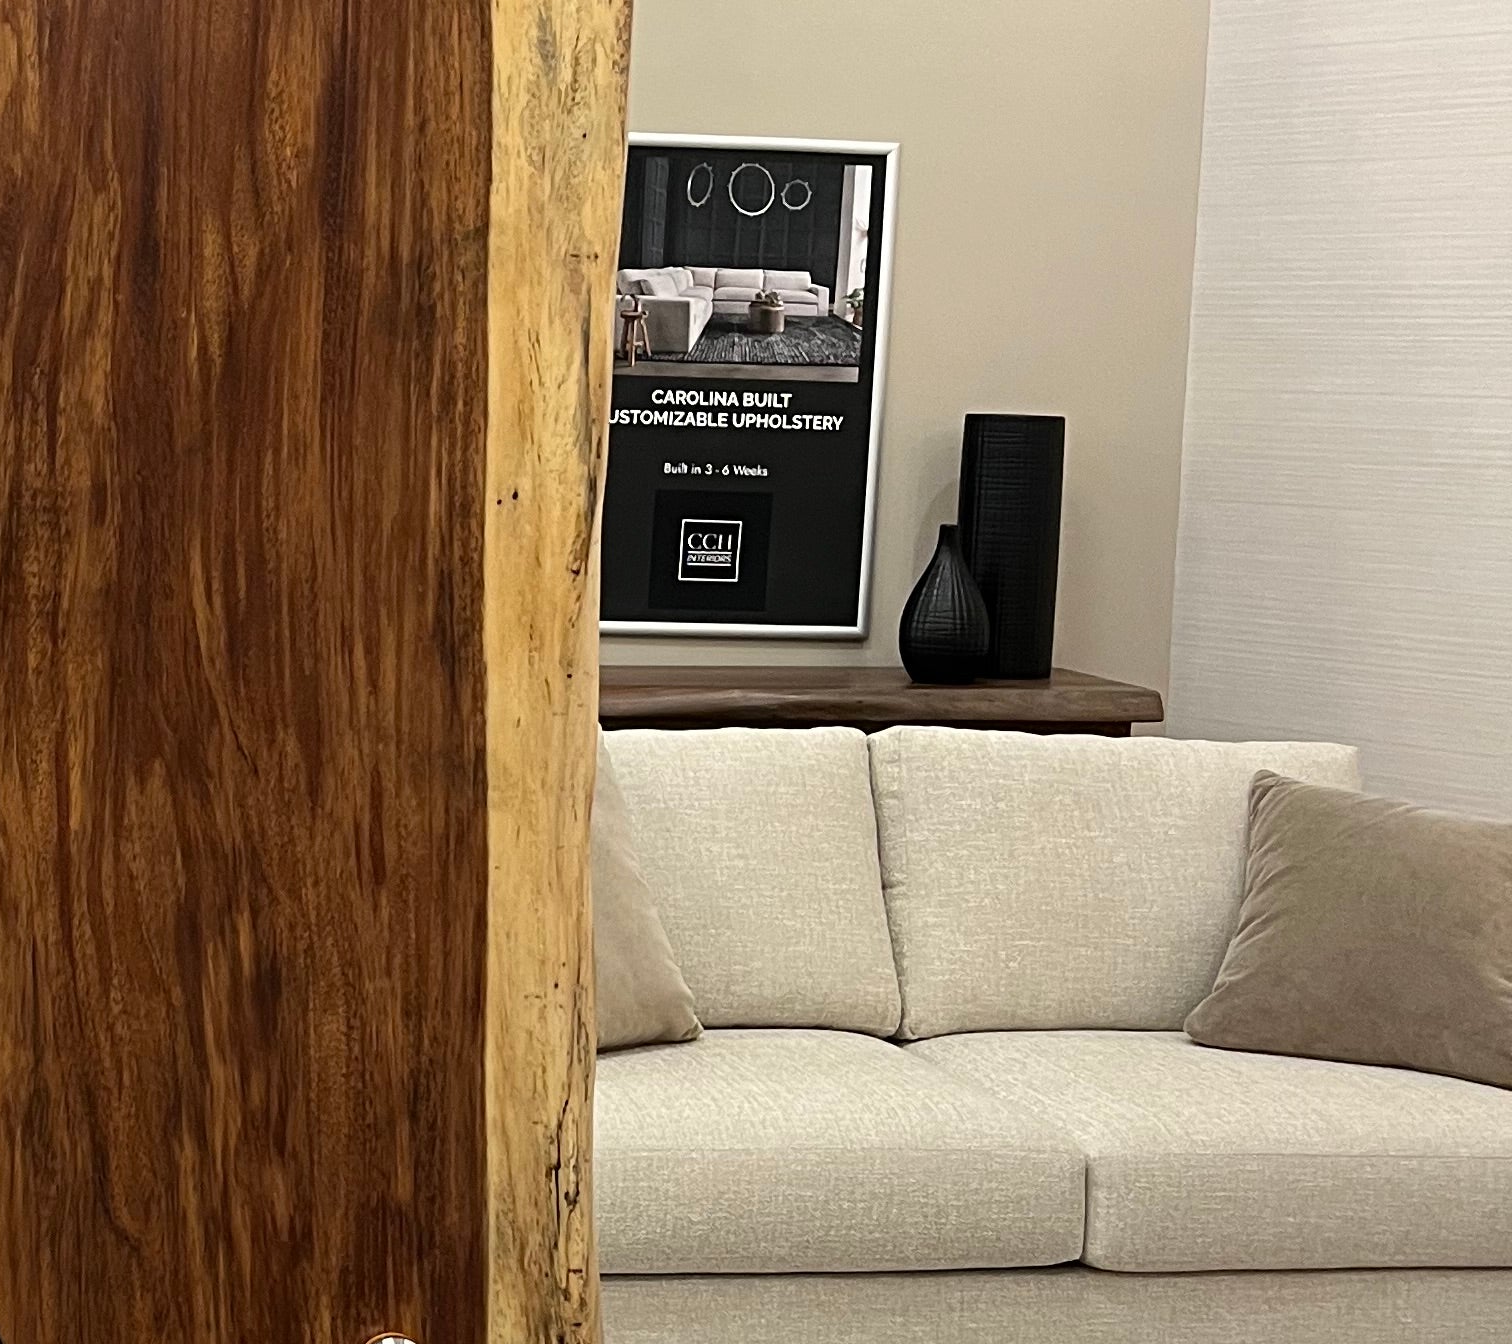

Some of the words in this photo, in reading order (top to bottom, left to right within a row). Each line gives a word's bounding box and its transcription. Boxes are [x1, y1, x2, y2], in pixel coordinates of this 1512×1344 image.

[651, 389, 739, 407] CAROLINA
[742, 392, 793, 409] BUILT
[732, 413, 844, 431] UPHOLSTERY
[664, 462, 688, 475] Built
[691, 463, 702, 475] in
[704, 463, 713, 475] 3
[721, 464, 730, 476] 6
[733, 465, 768, 477] Weeks
